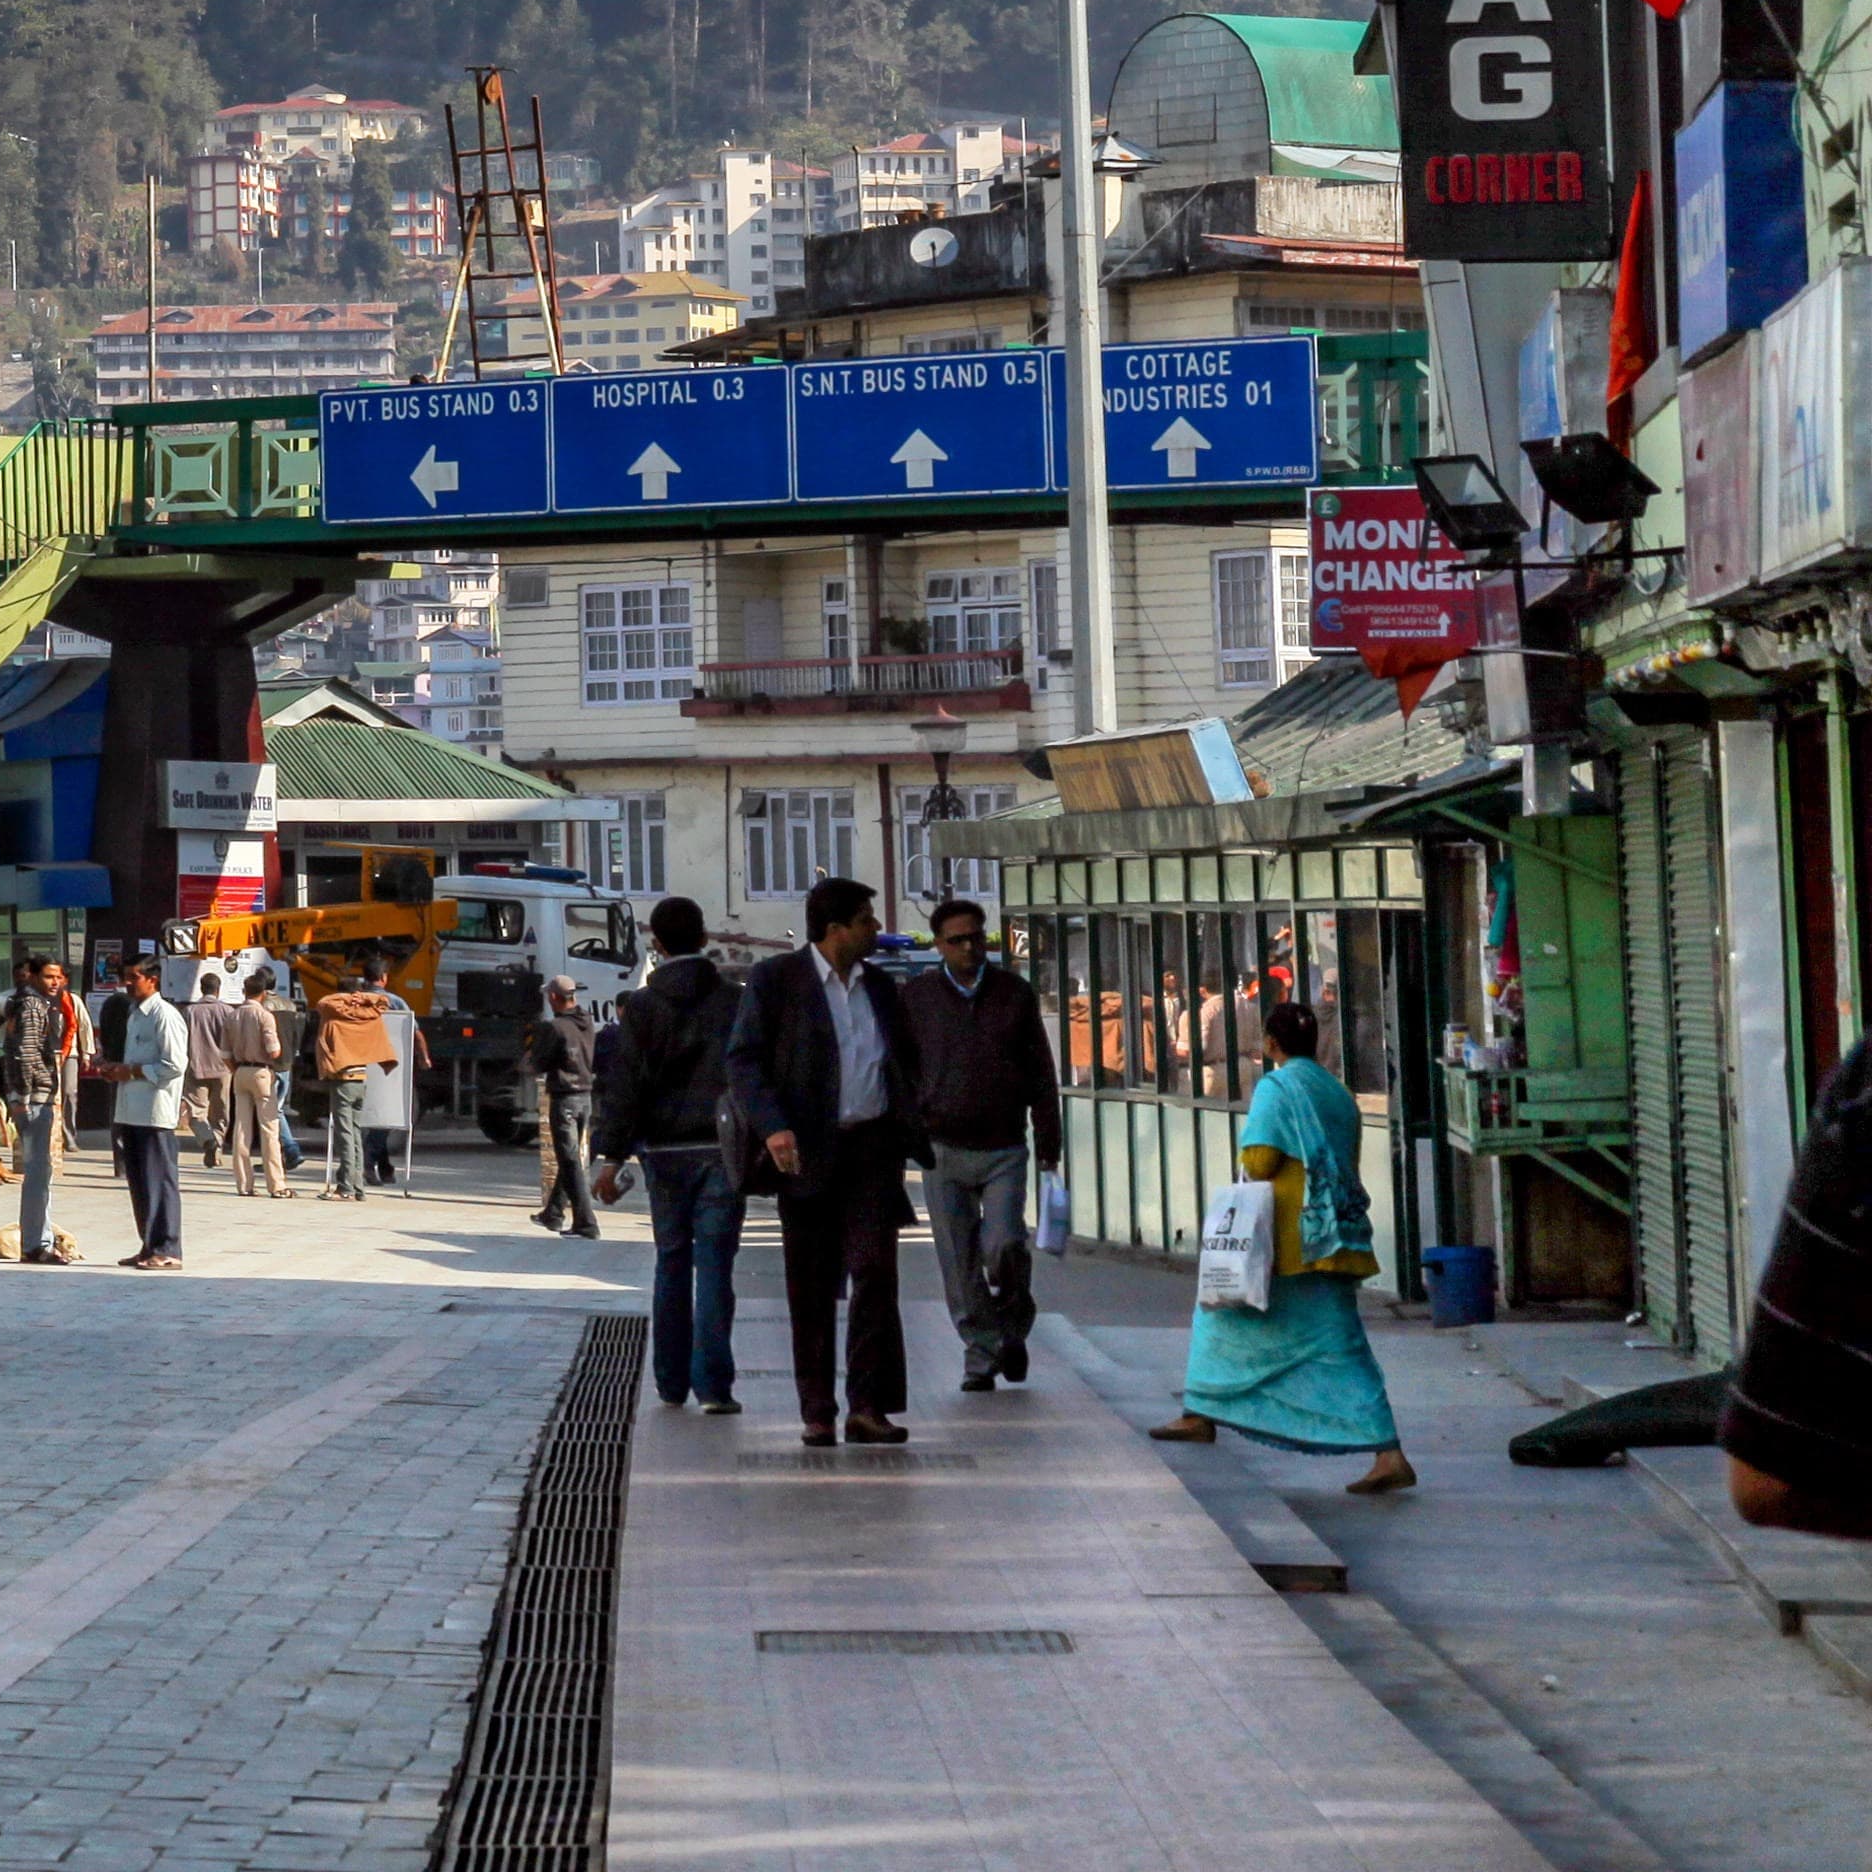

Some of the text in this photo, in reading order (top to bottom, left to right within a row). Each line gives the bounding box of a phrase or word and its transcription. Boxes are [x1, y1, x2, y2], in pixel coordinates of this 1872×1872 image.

[1425, 151, 1583, 205] CORNER
[801, 360, 1038, 398] S.N.T. BUS STAND 0.5
[1126, 350, 1232, 381] COTTAGE
[328, 389, 539, 424] PVT. BUS STAND 0.3
[593, 376, 745, 409] HOSPITAL 0.3
[1102, 380, 1272, 414] NDUSTRIES 01
[1324, 518, 1456, 551] MONE
[1314, 560, 1475, 593] CHANGER
[172, 789, 273, 811] SAFE DRINKING WATER
